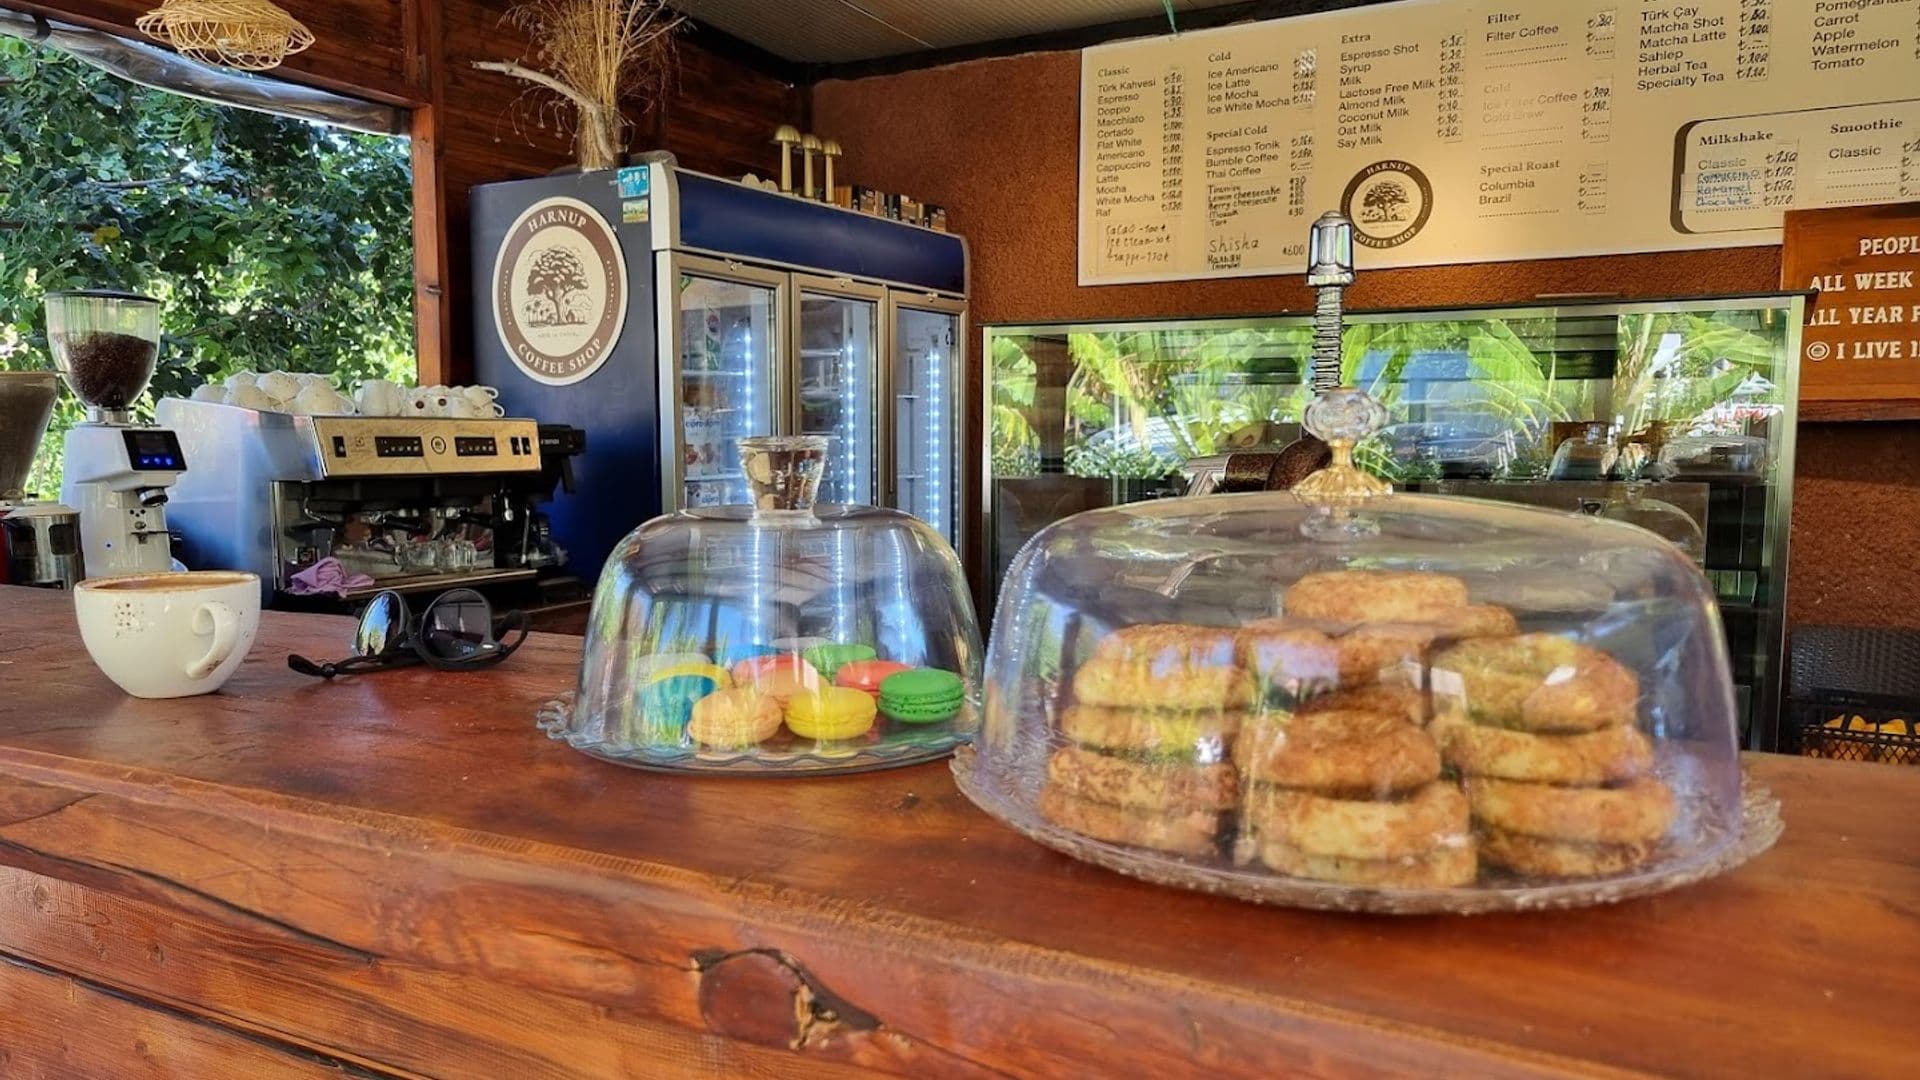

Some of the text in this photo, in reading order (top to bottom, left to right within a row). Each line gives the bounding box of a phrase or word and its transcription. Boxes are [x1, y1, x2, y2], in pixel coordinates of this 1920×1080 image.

[1487, 12, 1521, 25] Filter
[1641, 7, 1699, 21] Türk Çay
[1814, 13, 1860, 28] Carrot
[1640, 21, 1689, 36] Matcha
[1692, 16, 1725, 29] Shot
[1341, 34, 1371, 44] Extra
[1486, 31, 1516, 43] Filter
[1518, 25, 1559, 38] Coffee
[1639, 36, 1688, 49] Matcha
[1692, 30, 1727, 43] Latte
[1812, 28, 1856, 43] Apple
[1340, 48, 1391, 62] Espresso
[1393, 43, 1420, 56] Shot
[1811, 38, 1900, 56] Watermelon
[1207, 52, 1232, 62] Cold
[1639, 50, 1684, 63] Sahlep
[1207, 63, 1279, 79] Ice Americano
[1339, 63, 1372, 76] Syrup
[1638, 63, 1681, 76] Herbal
[1685, 61, 1708, 71] Tea
[1811, 57, 1865, 71] Tomato
[1097, 67, 1130, 77] Classic
[1120, 78, 1156, 90] Kahvesi
[1207, 78, 1251, 91] Ice Latte
[1339, 76, 1362, 86] Milk
[1637, 75, 1698, 91] Specialty
[1701, 72, 1725, 83] Tea
[1207, 89, 1259, 102] Ice Mocha
[1339, 87, 1382, 99] Lactose
[1384, 83, 1409, 93] Free
[1411, 80, 1436, 91] Milk
[1097, 93, 1140, 105] Espresso
[1207, 106, 1222, 114] Ice
[1224, 101, 1253, 112] White
[1255, 97, 1290, 109] Mocha
[1339, 99, 1380, 111] Almond
[1383, 96, 1406, 107] Milk
[1537, 92, 1578, 105] Coffee
[1097, 106, 1131, 116] Doppio
[1338, 111, 1384, 124] Coconut
[1386, 108, 1410, 119] Milk
[1097, 116, 1145, 127] Macchiato
[1829, 118, 1904, 135] Smoothie
[1097, 128, 1133, 138] Cortado
[1206, 125, 1268, 141] Special Cold
[1337, 126, 1357, 136] Oat
[1360, 123, 1382, 133] Milk
[1097, 138, 1142, 150] Flat White
[1360, 135, 1383, 146] Milk
[1699, 131, 1774, 146] Milkshake
[1096, 150, 1145, 160] Americano
[1206, 145, 1251, 156] Espresso
[1255, 140, 1280, 150] Tonik
[1828, 145, 1882, 159] Classic
[1096, 161, 1151, 173] Cappuccino
[1206, 156, 1241, 168] Bumble
[1245, 153, 1279, 164] Coffee
[1697, 157, 1748, 171] Classic
[1207, 167, 1261, 179] Thai Coffee
[1366, 161, 1411, 176] HARNUP
[1480, 160, 1561, 176] Special Roast
[1096, 175, 1119, 184] Latte
[1479, 179, 1536, 192] Columbia
[1096, 186, 1127, 195] Mocha
[1096, 197, 1121, 206] White
[1124, 194, 1155, 203] Mocha
[1479, 194, 1512, 205] Brazil
[527, 208, 588, 233] HARNUP
[1391, 226, 1417, 245] SHOP
[1809, 270, 1914, 292] ALL WEEK
[1848, 304, 1905, 325] YEAR
[518, 336, 601, 374] COFFEE SHOP
[1836, 342, 1846, 360] I
[1853, 340, 1903, 359] LIVE
